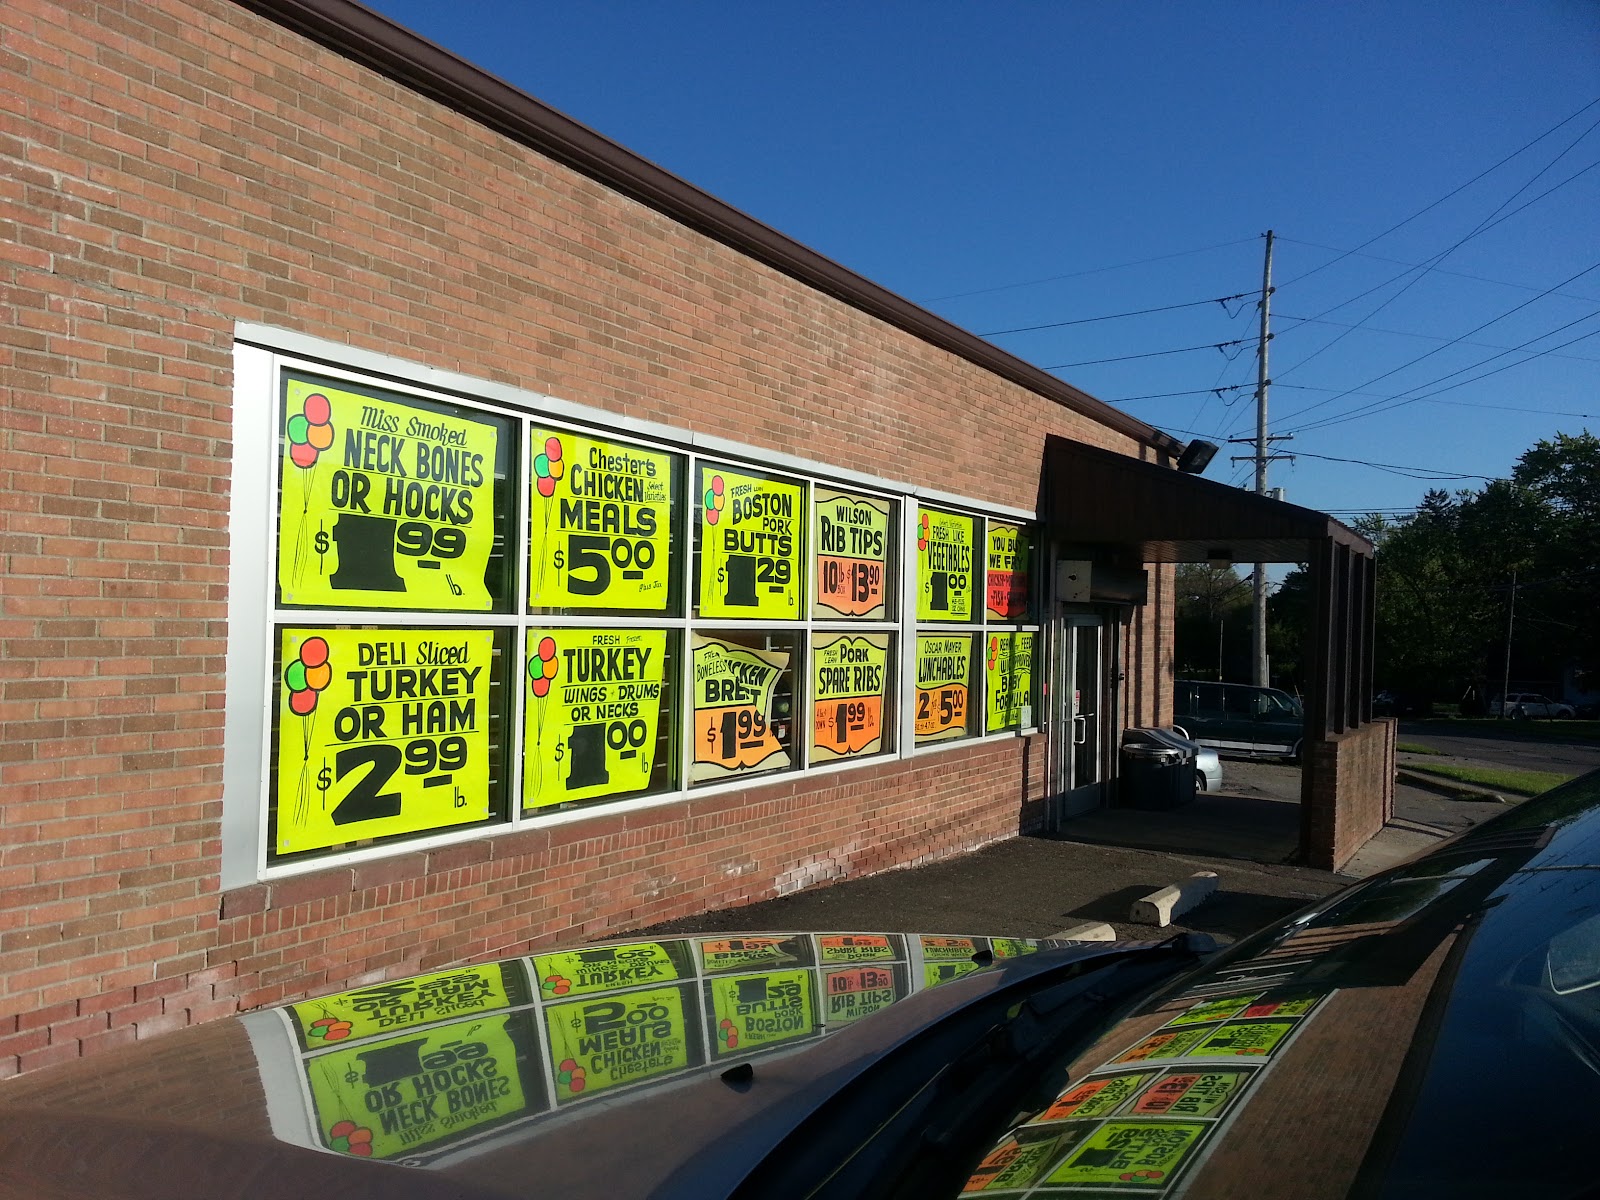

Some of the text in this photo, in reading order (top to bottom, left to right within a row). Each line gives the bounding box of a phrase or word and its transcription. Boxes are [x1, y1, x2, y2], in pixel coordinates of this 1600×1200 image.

[406, 416, 467, 446] Smoked
[344, 428, 484, 488] NECK BONES
[589, 447, 657, 477] Chester's
[570, 463, 644, 503] CHICKEN
[730, 484, 752, 499] FRESH
[331, 470, 474, 525] OR HOCKS
[732, 493, 792, 525] BOSTON
[560, 498, 657, 537] MEALS
[762, 517, 792, 536] PORK
[836, 505, 872, 526] WILSON
[724, 528, 793, 557] BUTTS
[820, 515, 883, 556] RIB TIPS
[932, 525, 965, 543] FRESH LIKE
[992, 536, 1005, 552] YOU
[927, 541, 970, 573] VEGETABLES
[990, 554, 1001, 568] WE
[823, 561, 838, 593] 10
[358, 641, 470, 666] DELI Sliced
[592, 635, 621, 645] FRESH
[840, 643, 869, 663] PORK
[924, 640, 962, 654] OSCAR MAYER
[1021, 637, 1032, 649] FEED
[563, 647, 653, 684] TURKEY
[696, 659, 727, 682] BONELESS
[918, 656, 966, 683] LUNCHABLES
[346, 666, 483, 702] TURKEY
[564, 686, 607, 704] WINGS
[618, 683, 660, 700] DRUMS
[818, 665, 882, 695] SPARE RIBS
[334, 698, 476, 742] OR HAM
[570, 702, 639, 722] OR NECKS
